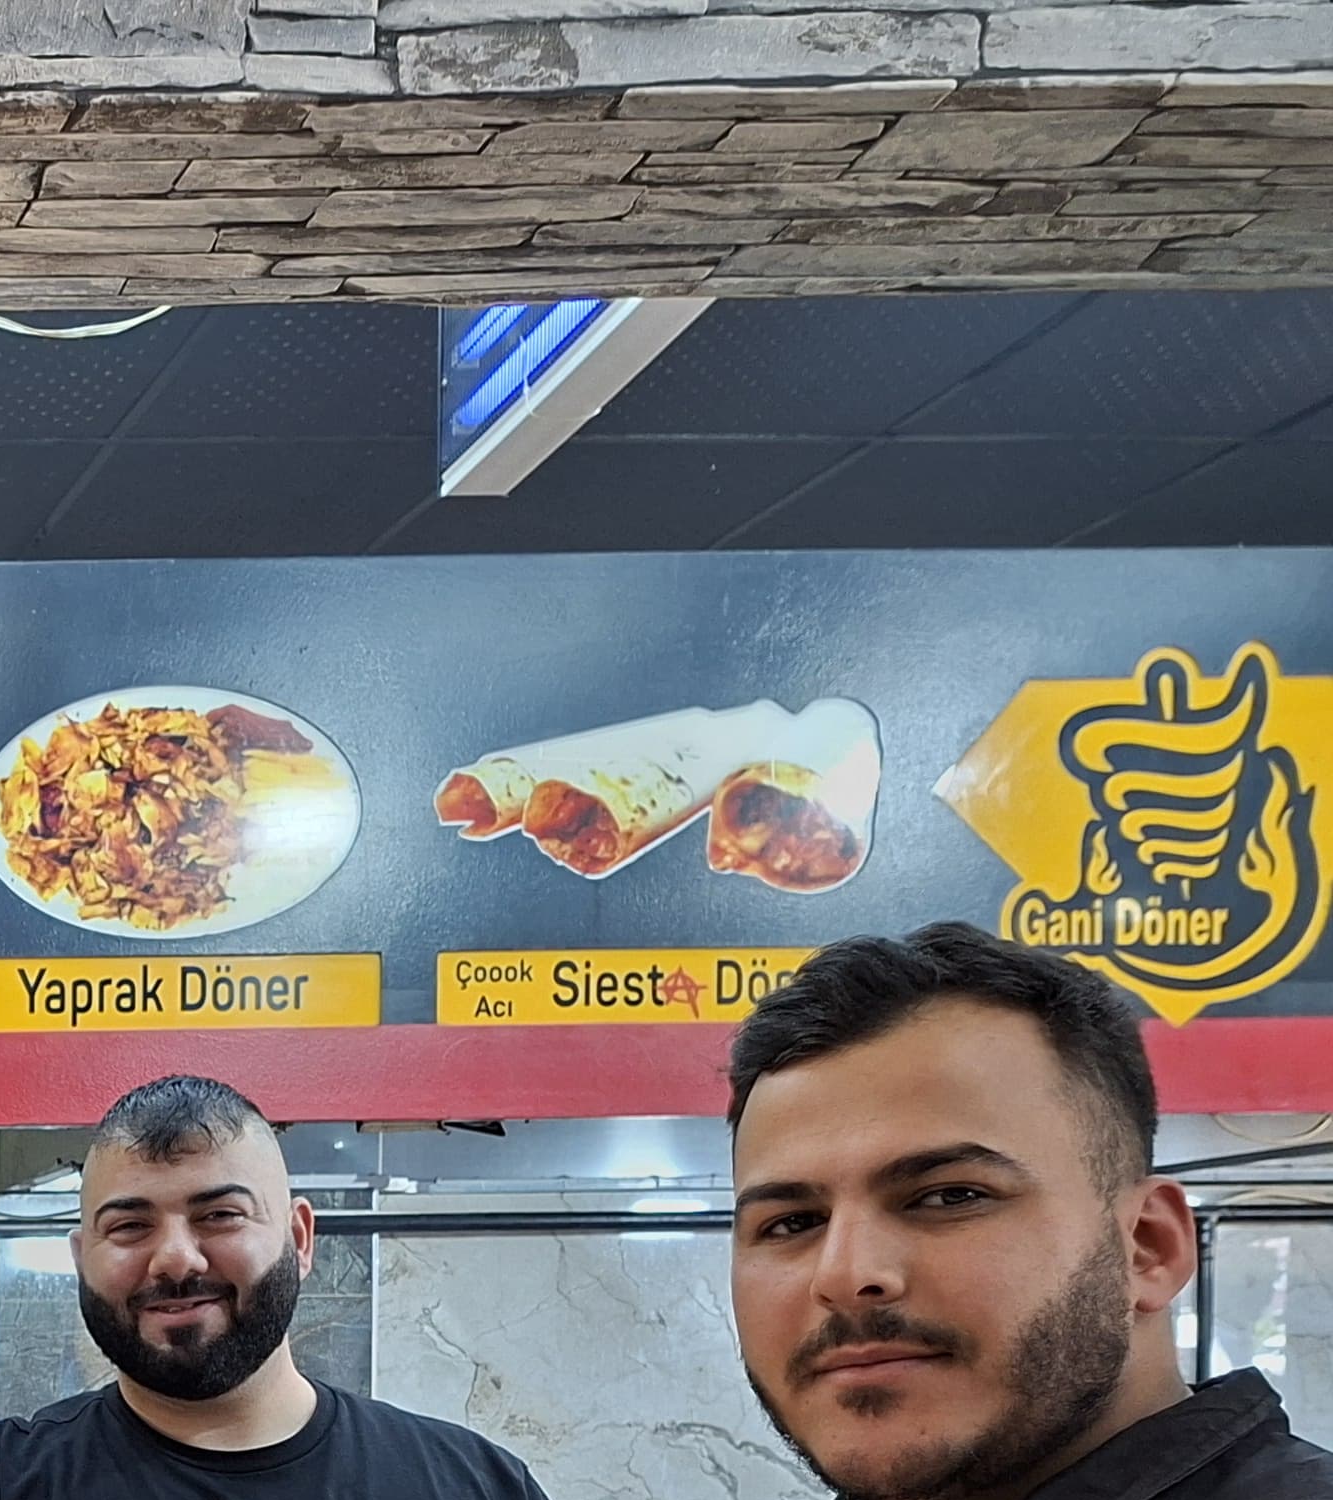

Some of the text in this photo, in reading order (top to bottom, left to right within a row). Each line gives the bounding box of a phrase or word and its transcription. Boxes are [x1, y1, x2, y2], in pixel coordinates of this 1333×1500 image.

[1020, 896, 1229, 946] Gani Döner
[455, 959, 533, 987] Çoook
[19, 963, 310, 1026] Yaprak Döner
[475, 996, 513, 1019] Acı
